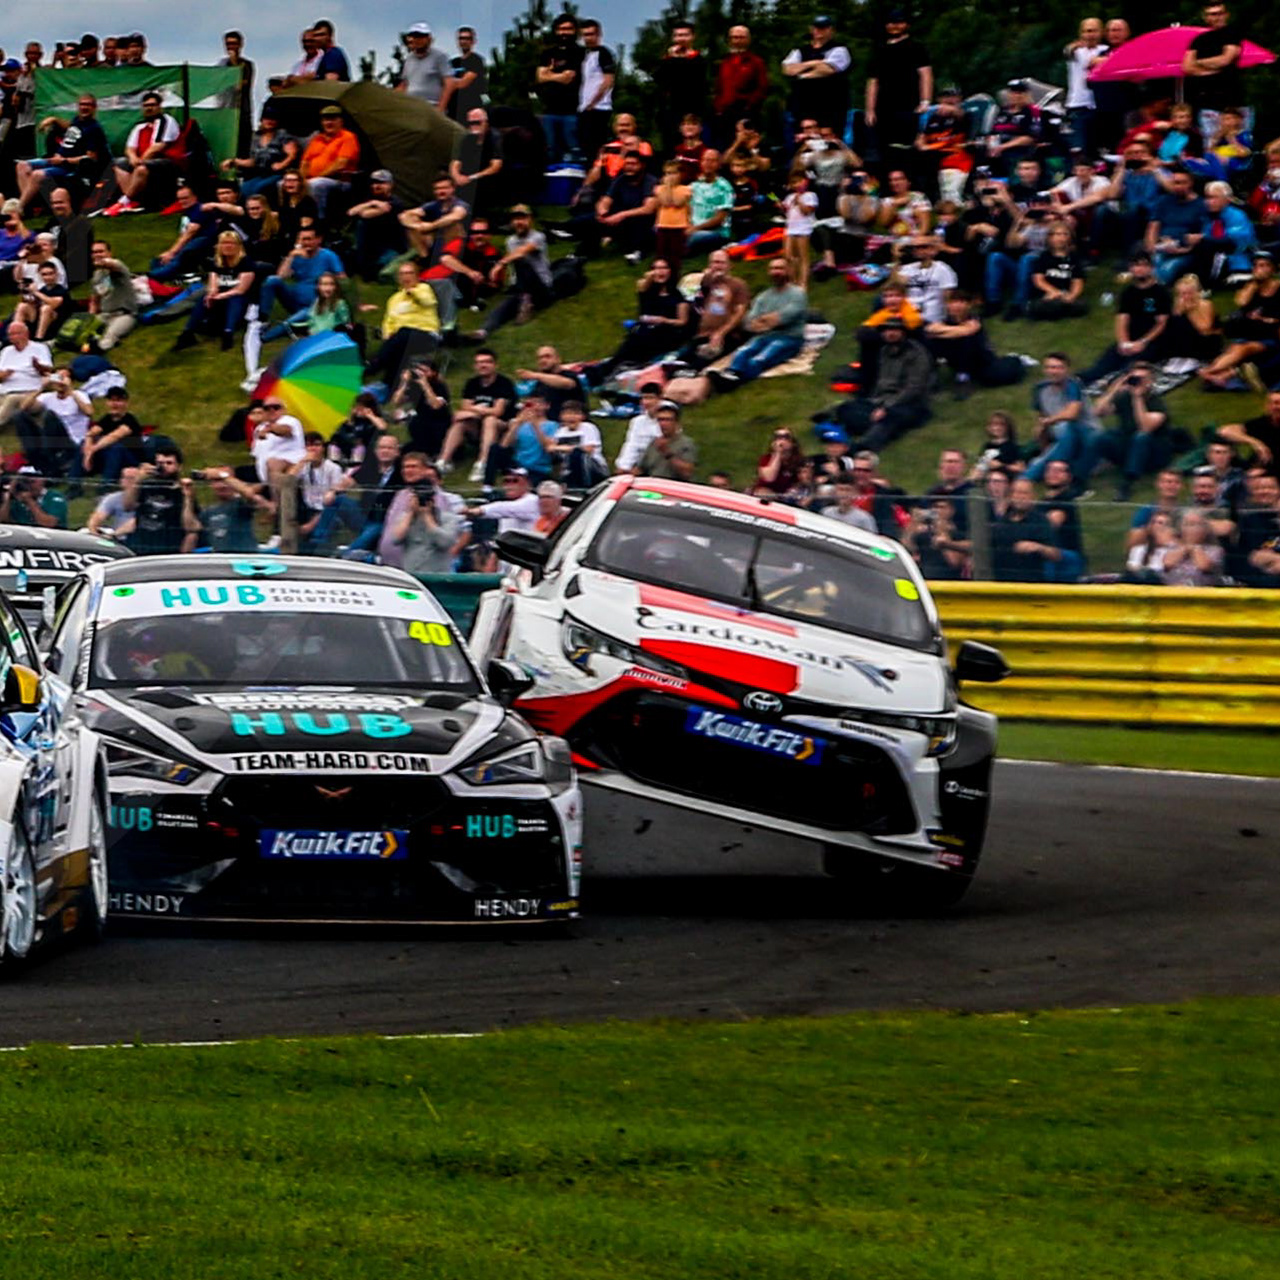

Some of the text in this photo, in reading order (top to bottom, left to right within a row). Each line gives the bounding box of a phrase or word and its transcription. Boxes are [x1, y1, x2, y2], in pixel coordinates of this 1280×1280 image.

[160, 585, 266, 608] HUB
[408, 621, 452, 647] 40
[636, 606, 844, 671] Cardowan
[230, 712, 413, 739] HUB
[232, 753, 431, 772] TEAM-HARD.COM
[466, 814, 516, 838] HUB
[107, 893, 184, 913] HENDY
[474, 898, 541, 917] HENDY
